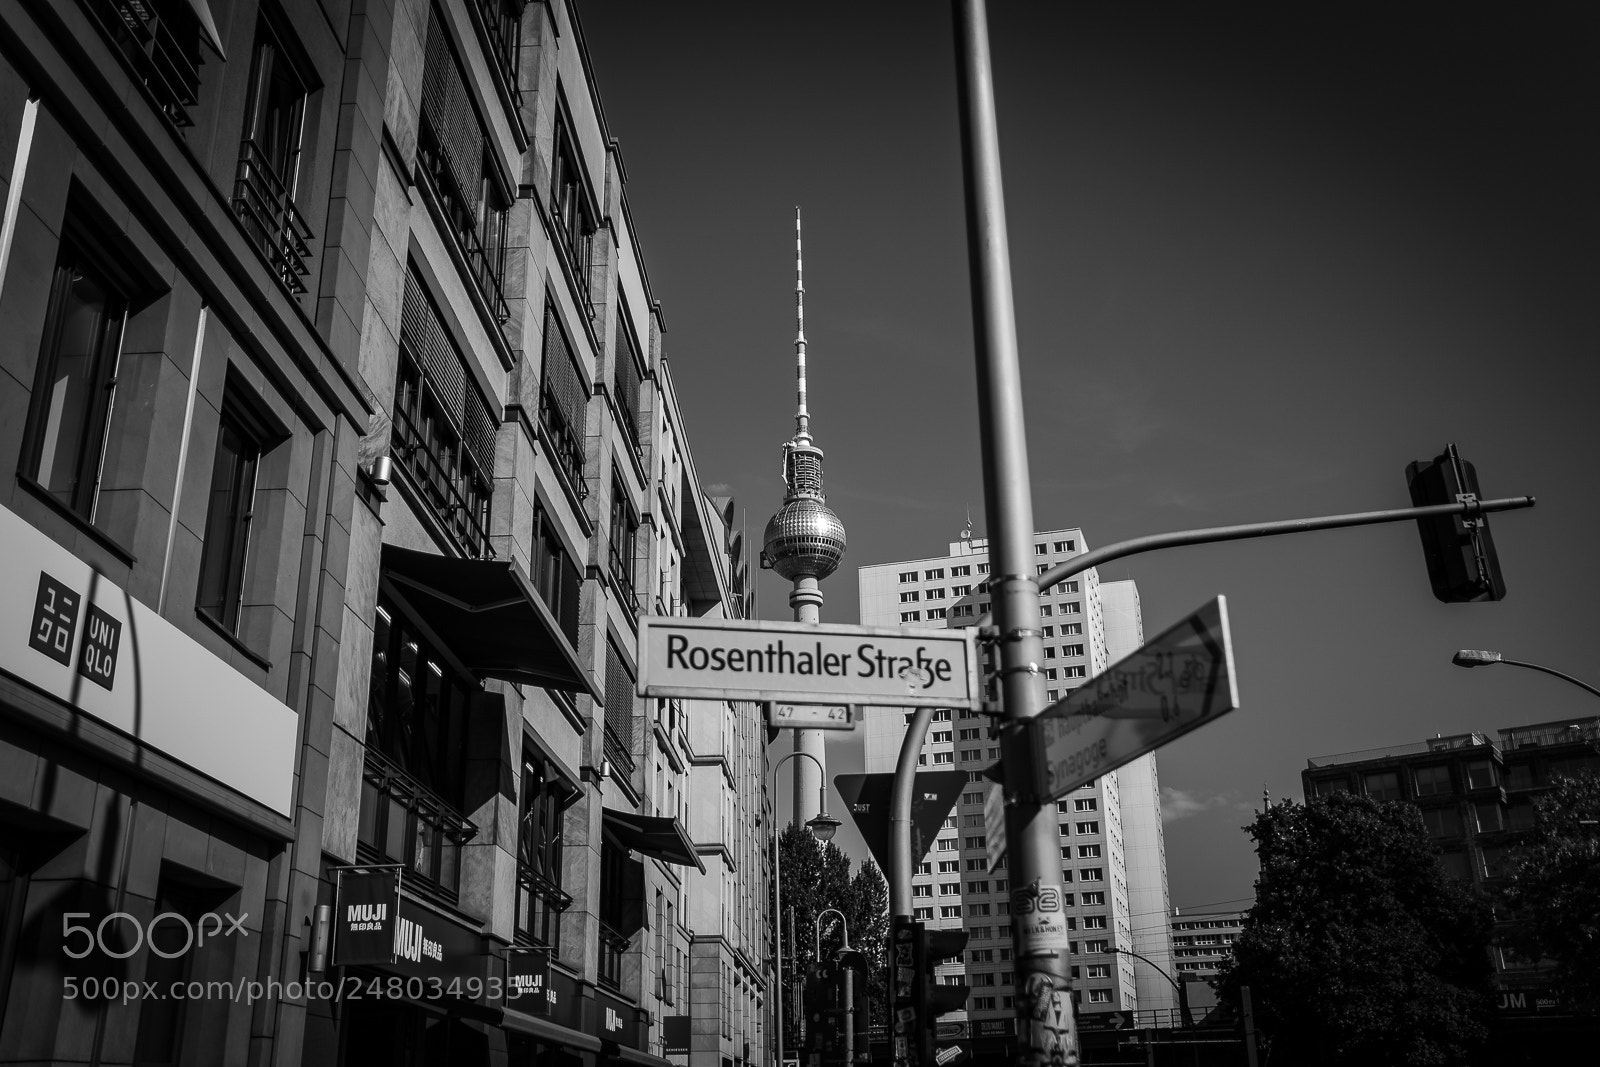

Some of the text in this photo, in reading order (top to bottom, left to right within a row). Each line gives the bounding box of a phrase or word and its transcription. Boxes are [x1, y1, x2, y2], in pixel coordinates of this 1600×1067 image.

[89, 614, 115, 650] UNI
[85, 644, 112, 678] QLO
[667, 633, 952, 689] Rosenthaler Straße
[778, 706, 793, 717] 47
[828, 708, 844, 719] 42
[347, 903, 387, 922] MUJI
[393, 916, 423, 963] MUJI
[514, 974, 542, 987] MUJI
